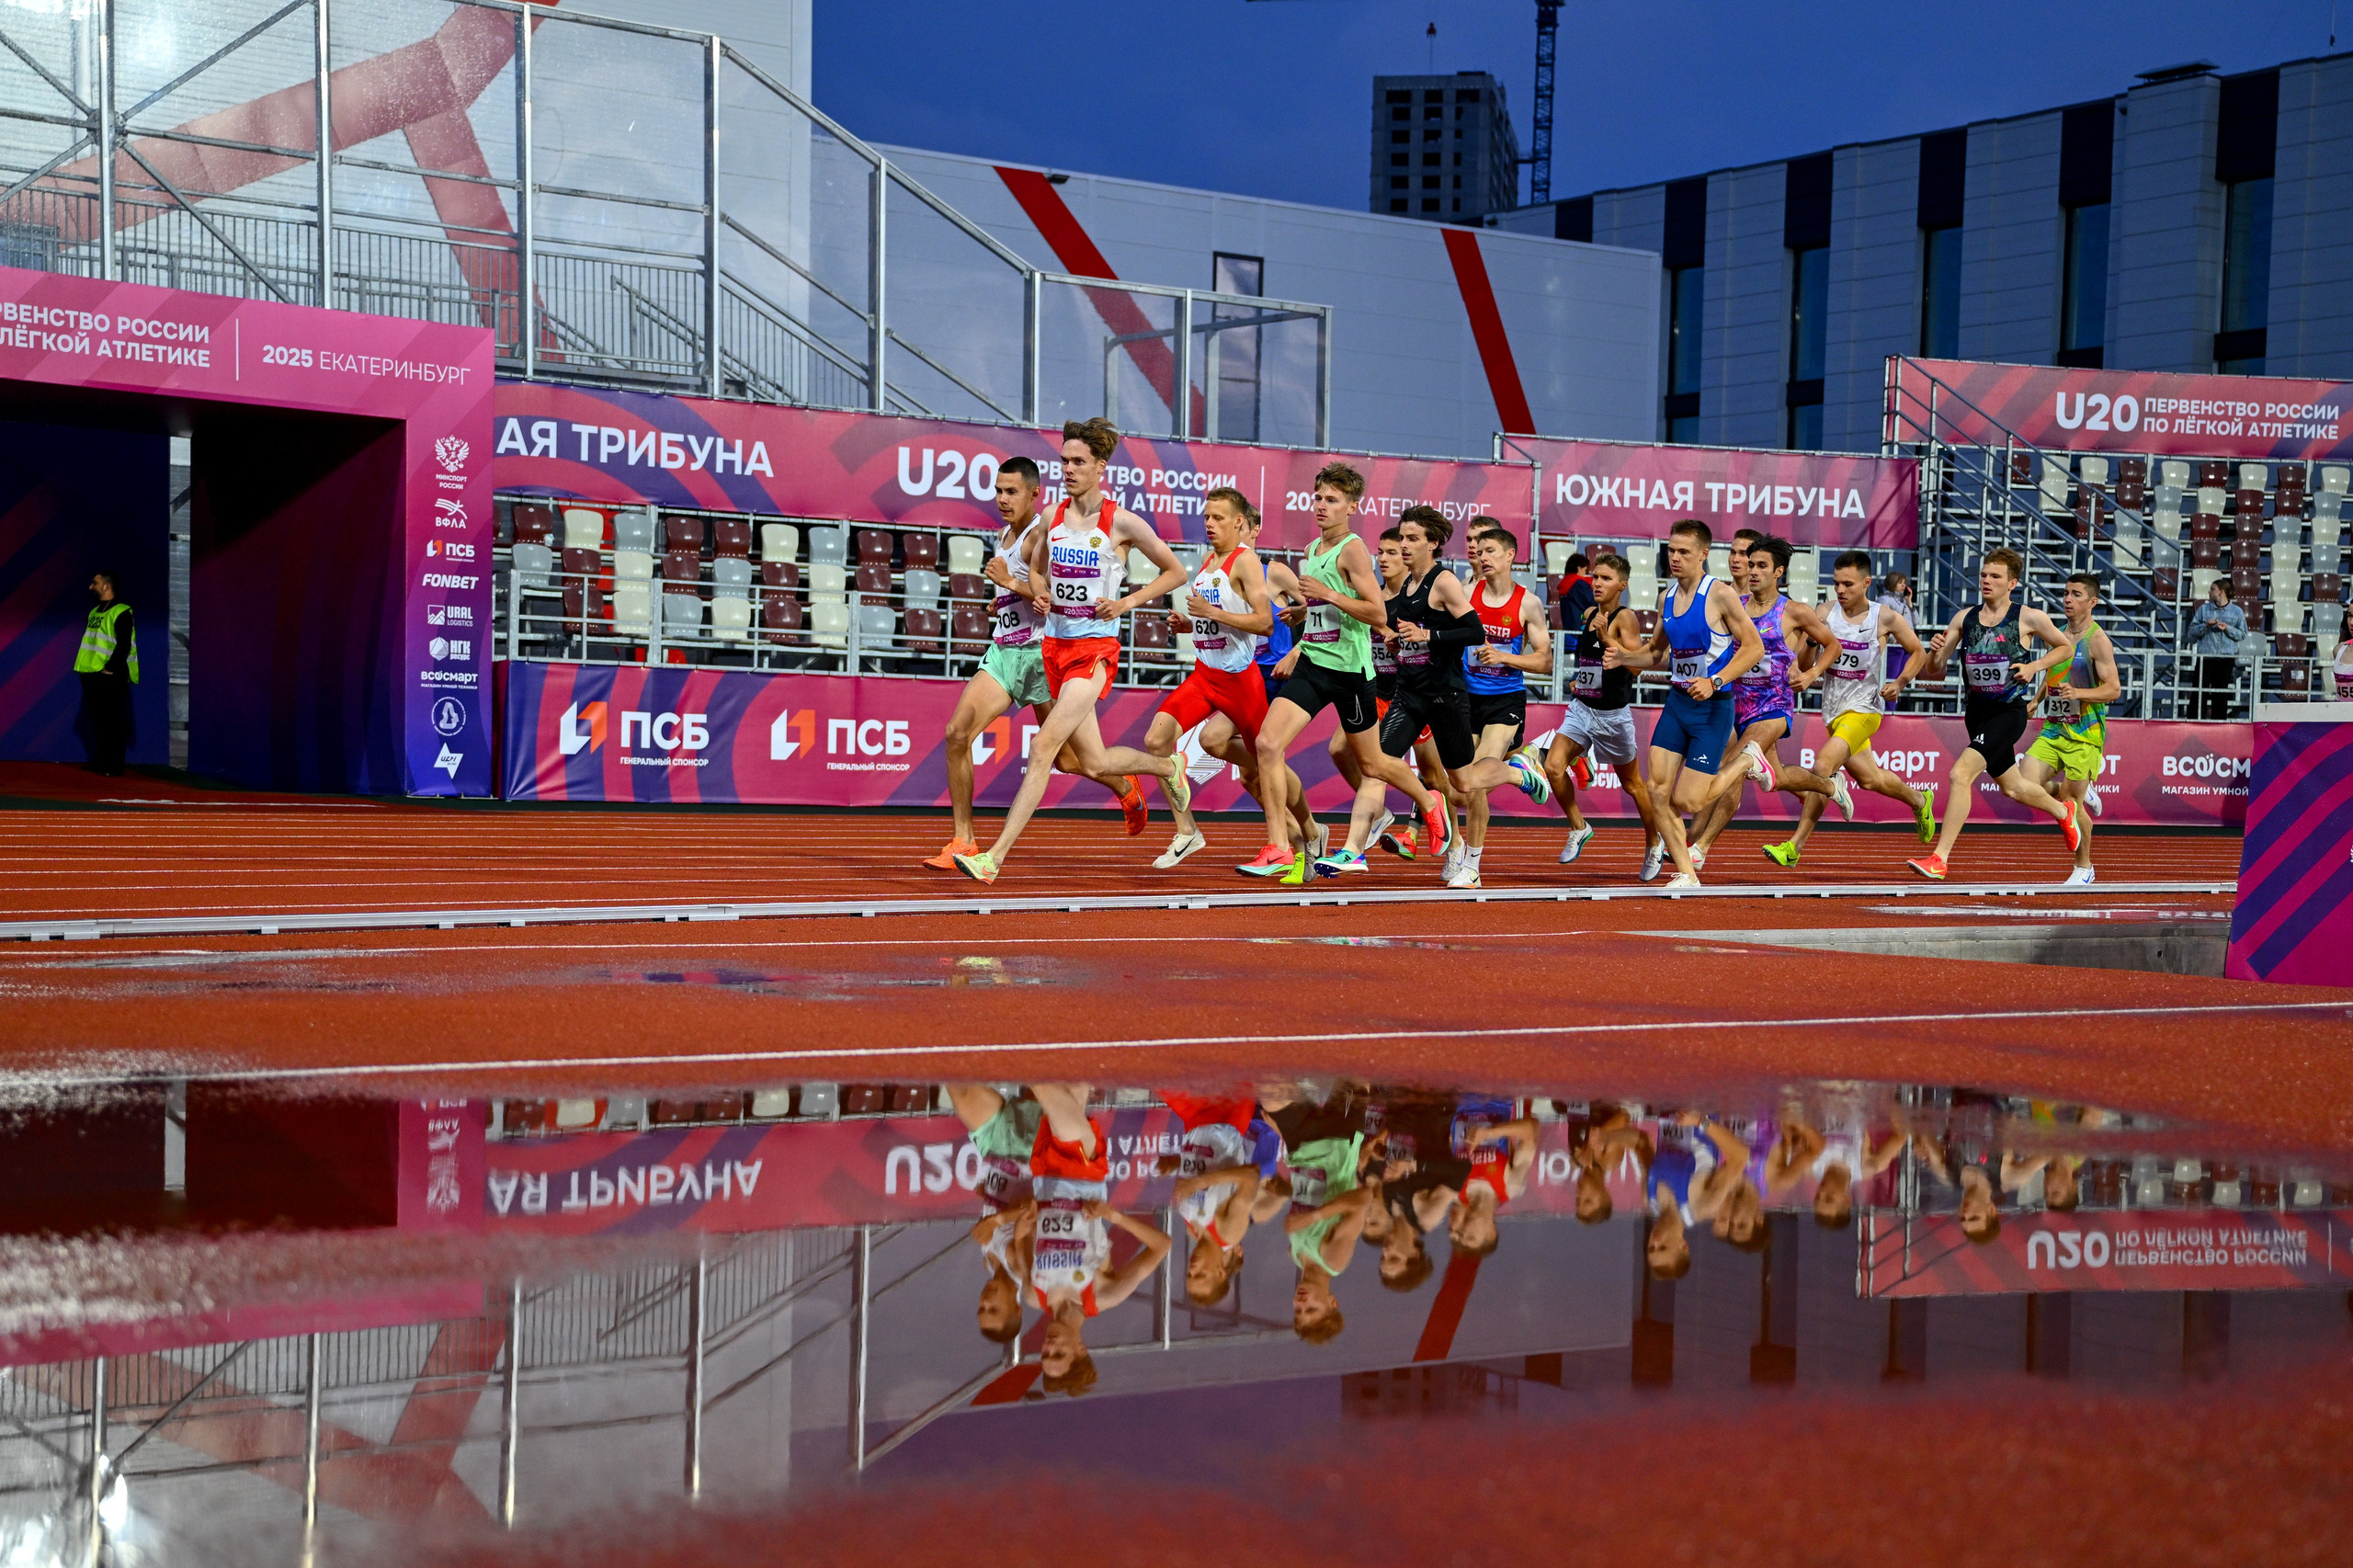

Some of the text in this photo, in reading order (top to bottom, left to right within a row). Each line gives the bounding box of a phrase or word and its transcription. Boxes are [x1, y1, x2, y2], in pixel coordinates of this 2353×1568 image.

[0, 302, 210, 344] ВЕНСТВО РОССИИ
[0, 324, 210, 368] ЛЁГКОЙ АТЛЕТИКЕ
[262, 344, 471, 385] 2025 ЕКАТЕРИНБУРГ
[2056, 392, 2139, 432] U20
[2144, 397, 2339, 420] ПЕРВЕНСТВО РОССИИ
[2143, 414, 2338, 440] ПО ЛЁГКОЙ АТЛЕТИКЕ
[572, 424, 774, 478] ТРИБУНА
[436, 473, 467, 483] МИНСПОРТ
[898, 447, 998, 501] U20
[1151, 469, 1236, 491] РОССИИ
[439, 482, 463, 490] РОССИИ
[1556, 473, 1866, 518] ЮЖНАЯ ТРИБУНА
[1131, 493, 1208, 516] АТЛЕТИ
[436, 517, 466, 528] ВФЛА
[446, 543, 475, 557] ПСБ
[1051, 546, 1099, 566] RUSSIA
[422, 574, 479, 589] FONBET
[1056, 583, 1087, 602] 623
[447, 606, 473, 619] URAL
[1311, 612, 1323, 627] 71
[1196, 620, 1219, 635] 620
[1677, 664, 1698, 676] 407
[1972, 668, 2001, 680] 399
[2051, 700, 2070, 712] 312
[620, 710, 710, 750] ПСБ
[828, 719, 911, 756] ПСБ
[620, 756, 709, 767] ГЕНЕРАЛЬНЫЙ СПОНСОР
[827, 762, 910, 771] ГЕНЕРАЛЬНЫЙ СПОНСОР
[2162, 786, 2249, 796] МАГАЗИН УМНОЙ
